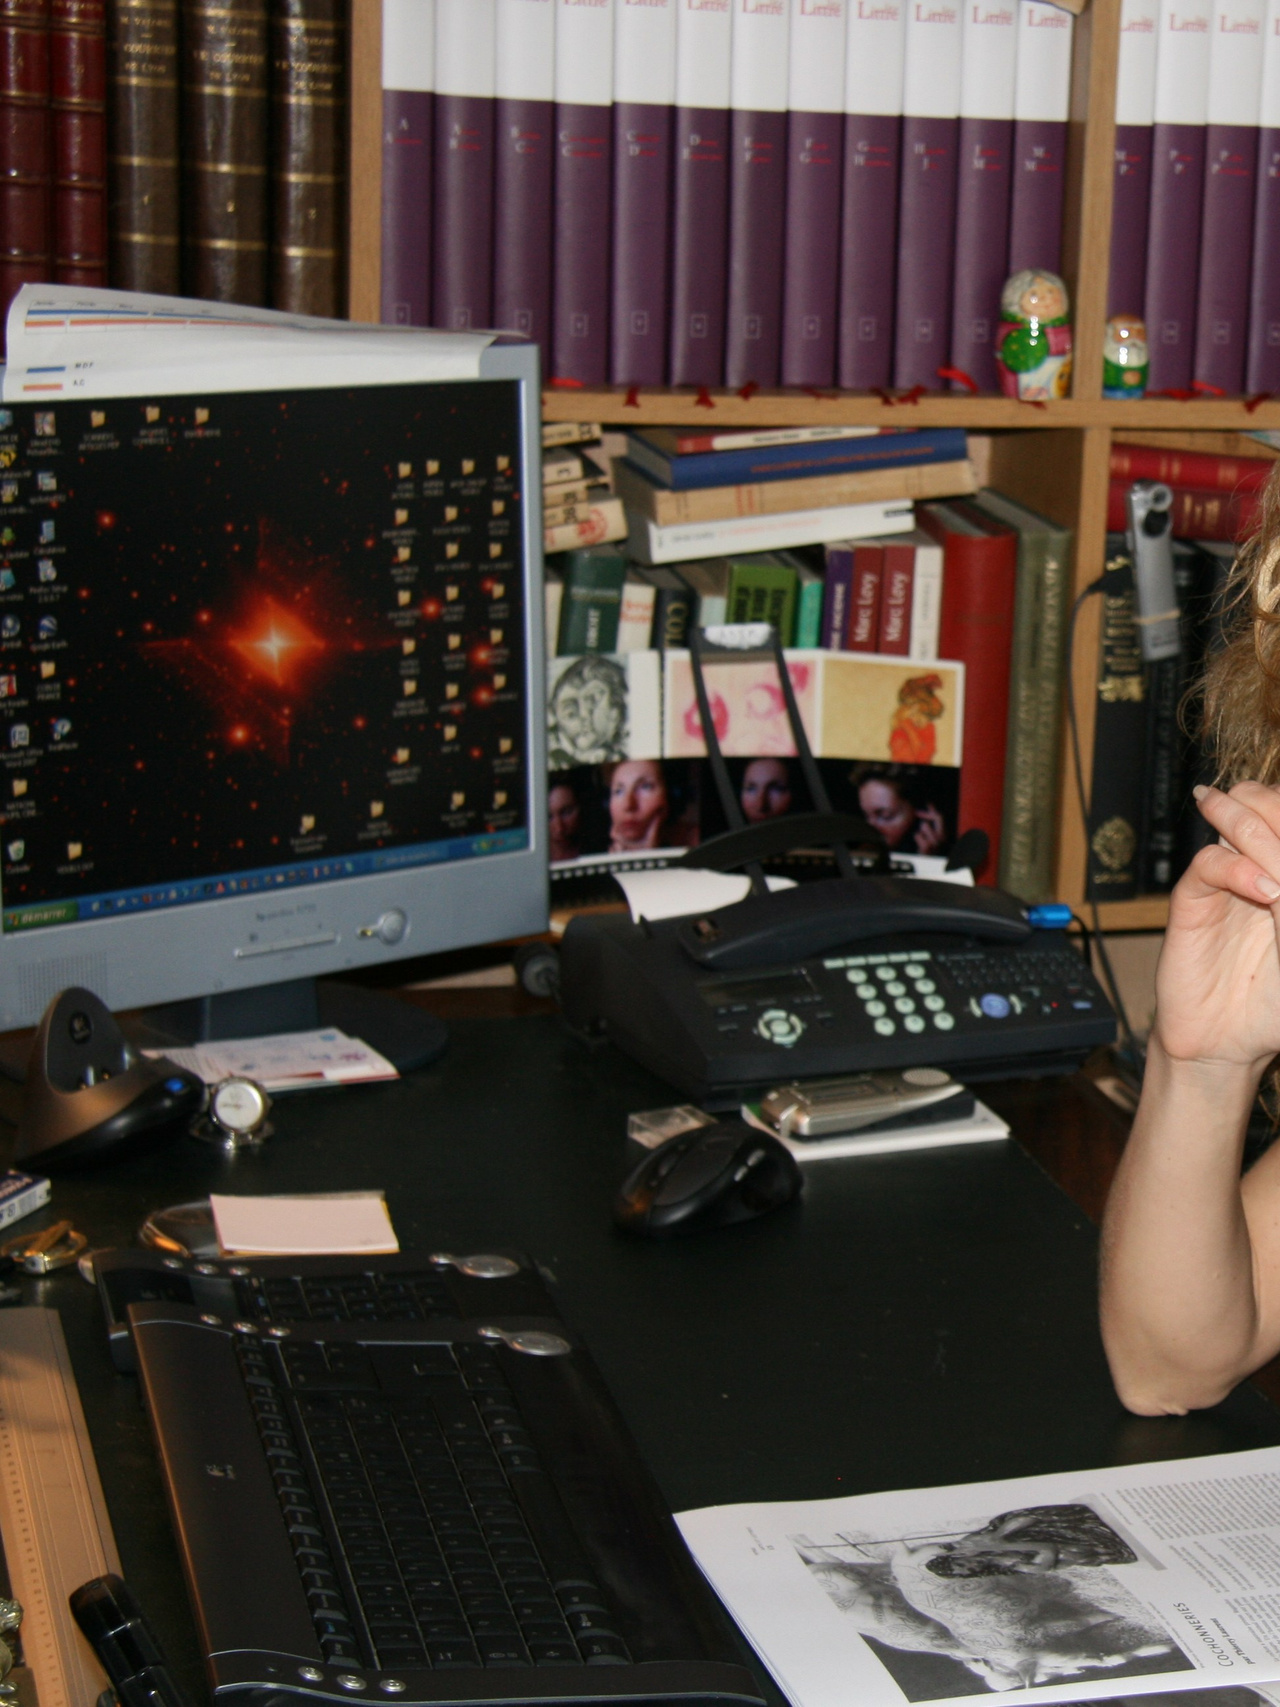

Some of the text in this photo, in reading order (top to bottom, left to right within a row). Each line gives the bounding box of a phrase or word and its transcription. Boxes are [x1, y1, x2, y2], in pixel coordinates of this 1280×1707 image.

[855, 573, 879, 642] Marc Levy
[886, 572, 909, 642] Marc Levy
[1173, 1602, 1234, 1667] COCHONNERIES
